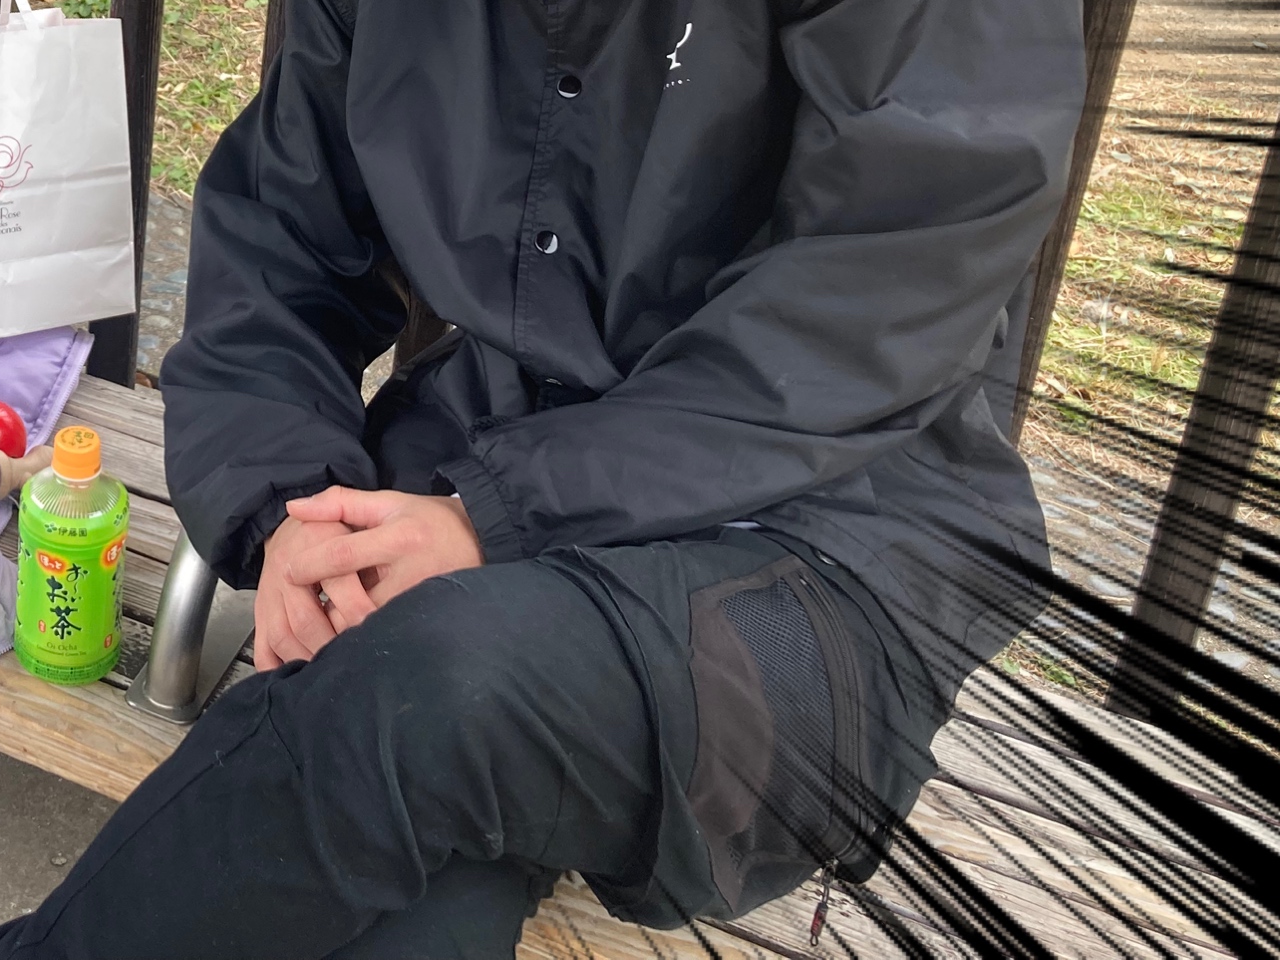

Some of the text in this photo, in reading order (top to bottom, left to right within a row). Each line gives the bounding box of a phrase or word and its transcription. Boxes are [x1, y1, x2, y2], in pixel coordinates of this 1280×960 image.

[0, 206, 21, 220] Rose
[39, 554, 63, 570] ほっと
